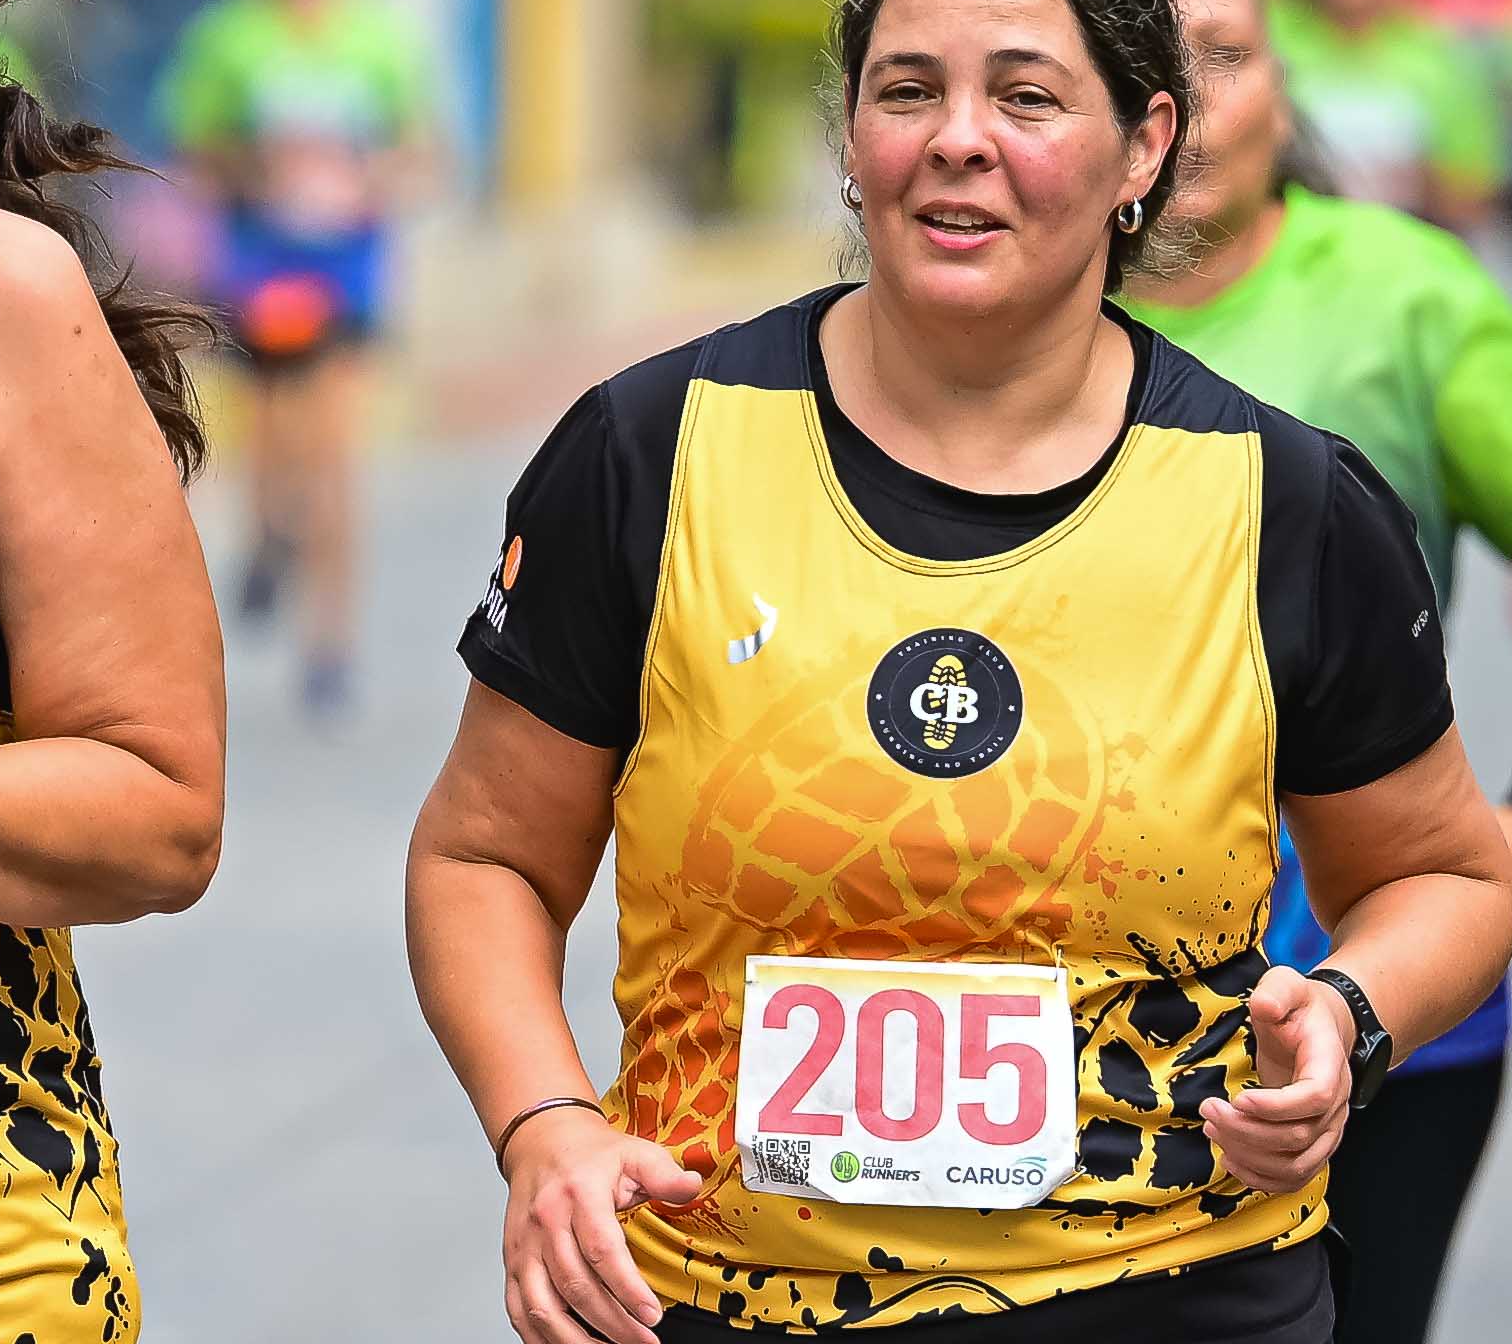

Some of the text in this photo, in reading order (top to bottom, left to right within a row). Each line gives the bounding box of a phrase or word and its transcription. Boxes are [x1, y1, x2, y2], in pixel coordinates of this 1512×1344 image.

[909, 682, 979, 724] CB
[757, 984, 1049, 1145] 205
[864, 1156, 893, 1168] CLUB
[946, 1166, 1044, 1186] CARUSO
